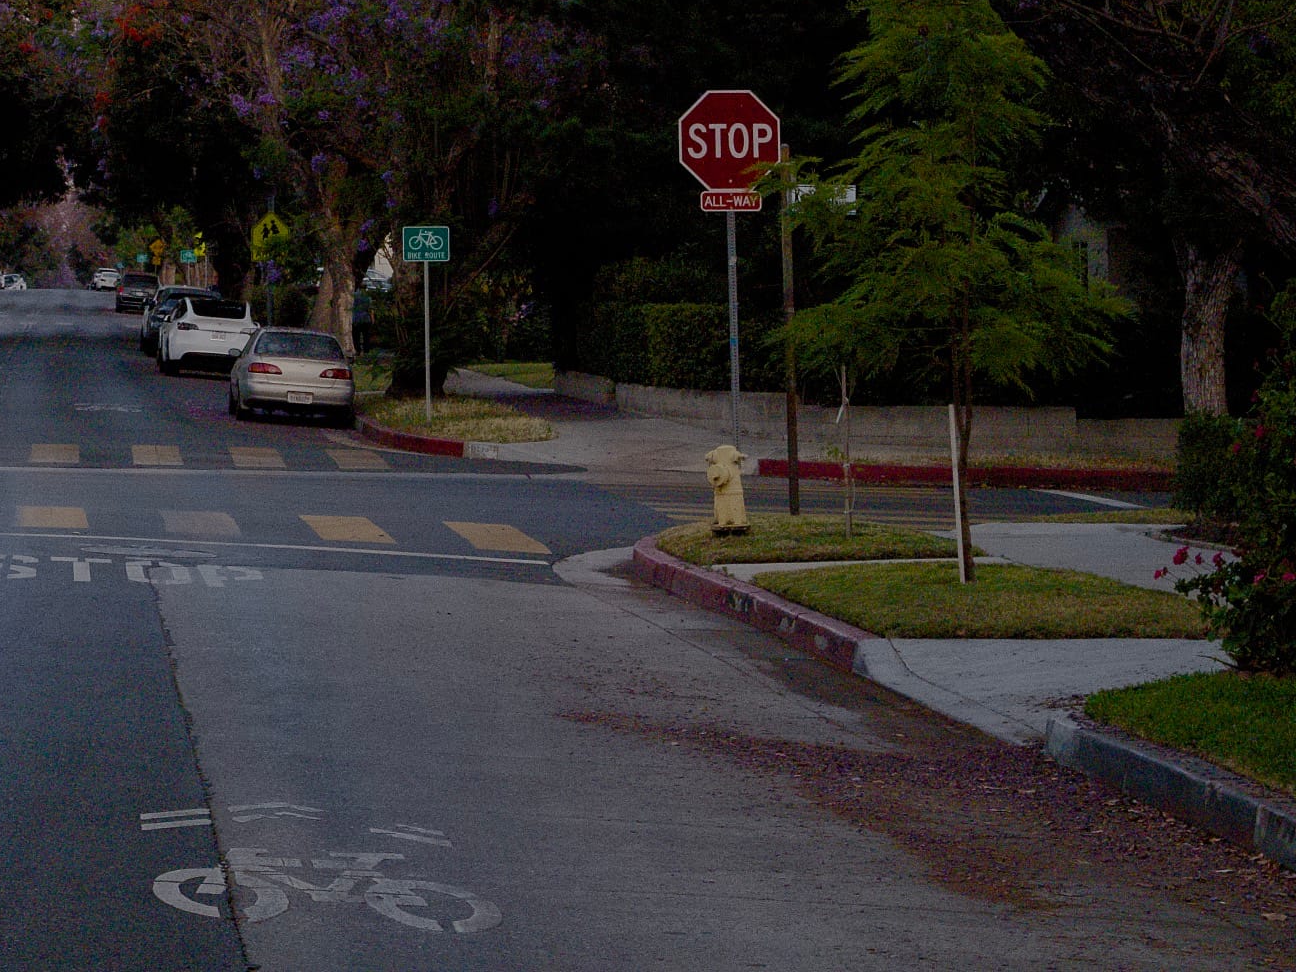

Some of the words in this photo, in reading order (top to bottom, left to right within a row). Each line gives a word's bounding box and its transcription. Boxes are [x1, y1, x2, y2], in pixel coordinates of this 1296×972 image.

[687, 123, 773, 159] STOP
[704, 195, 758, 207] ALL-WAY
[407, 251, 422, 260] BIKE
[424, 251, 446, 259] ROUTE
